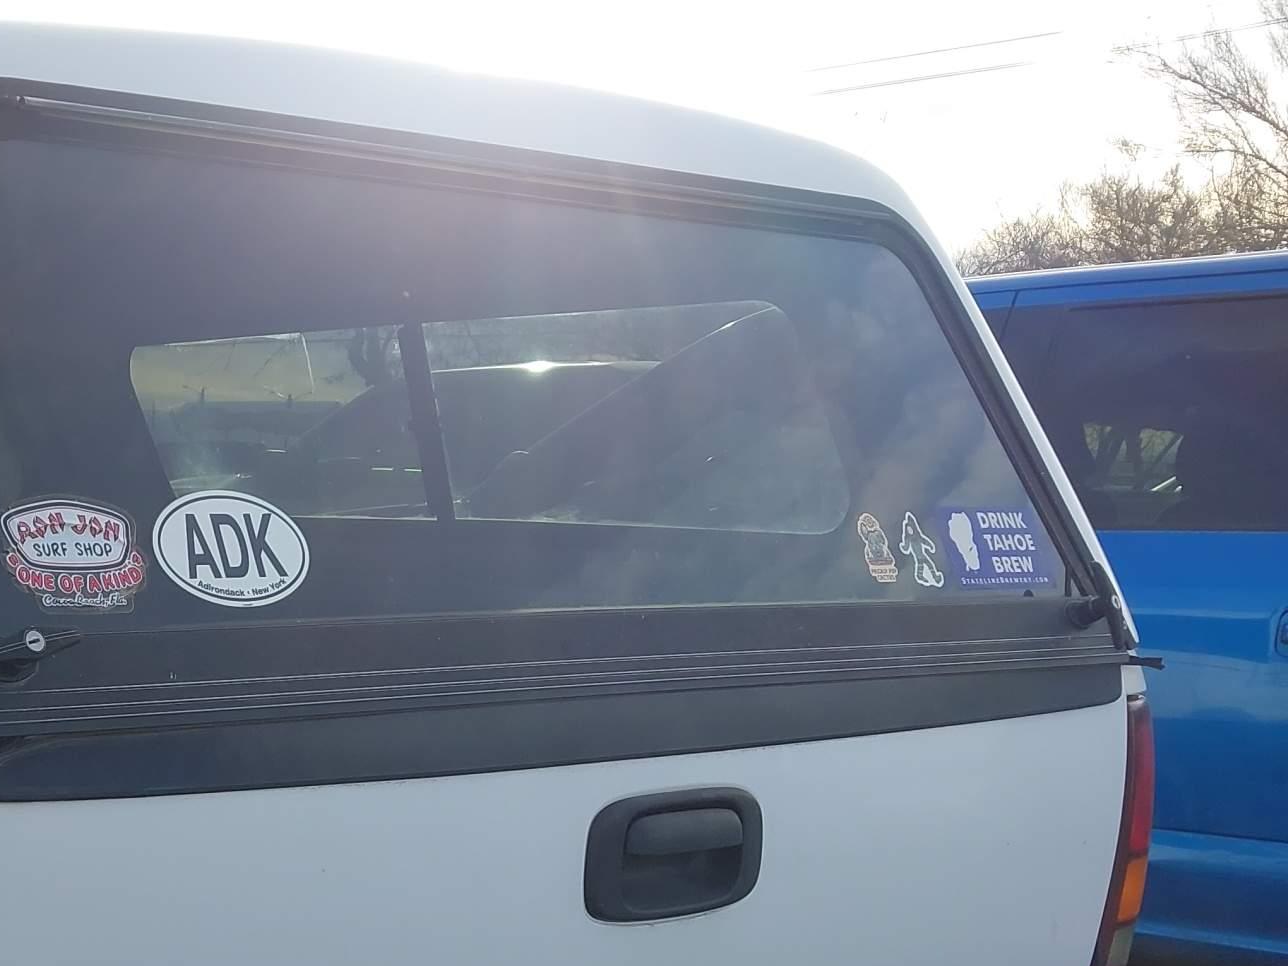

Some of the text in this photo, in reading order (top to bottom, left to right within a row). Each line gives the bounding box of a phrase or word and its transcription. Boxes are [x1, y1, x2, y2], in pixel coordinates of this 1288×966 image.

[17, 512, 120, 544] RON JON
[976, 511, 1027, 529] DRINK
[32, 542, 112, 557] SURF SHOP
[185, 513, 289, 579] ADK
[984, 534, 1036, 551] TAHOE
[992, 556, 1034, 573] BREW
[58, 573, 84, 593] OF
[87, 574, 102, 593] A
[198, 578, 286, 597] Adirondack New York
